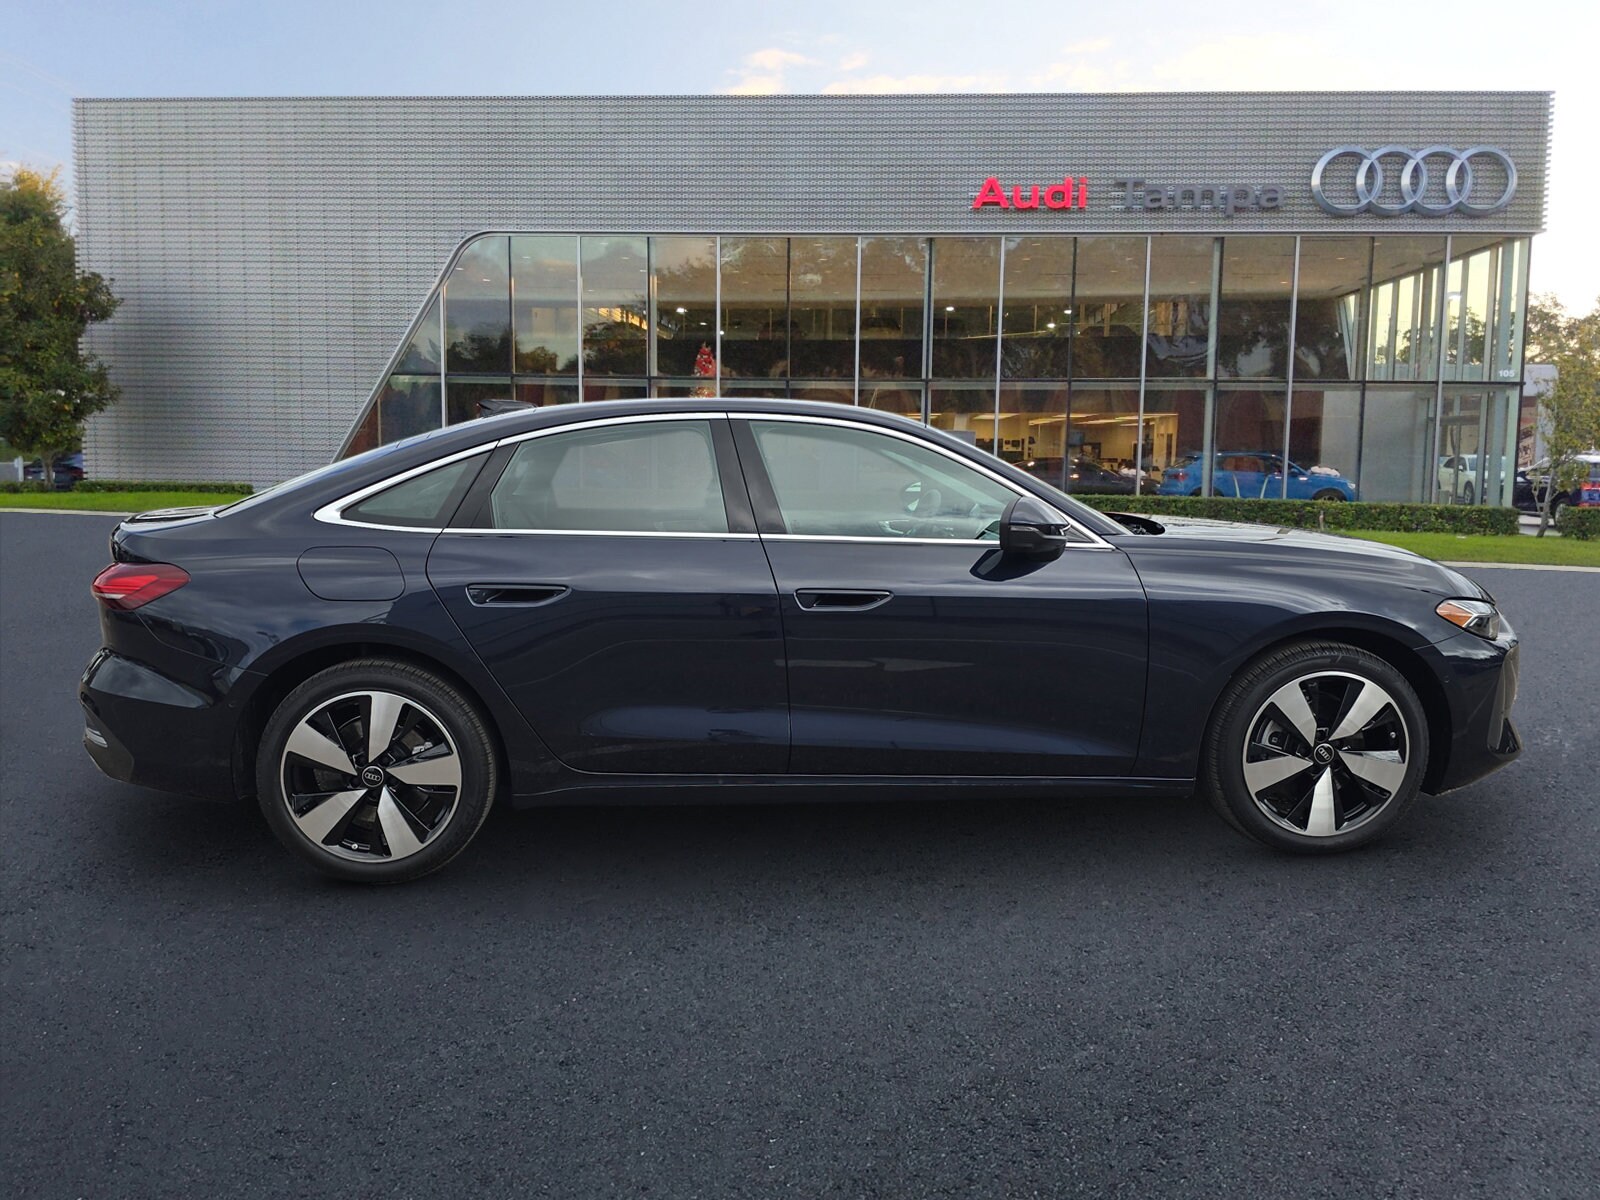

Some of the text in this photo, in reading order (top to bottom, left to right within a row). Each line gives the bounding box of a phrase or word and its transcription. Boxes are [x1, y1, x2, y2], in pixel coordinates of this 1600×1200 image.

[972, 176, 1284, 217] Audi Tampa
[1498, 369, 1515, 378] 105
